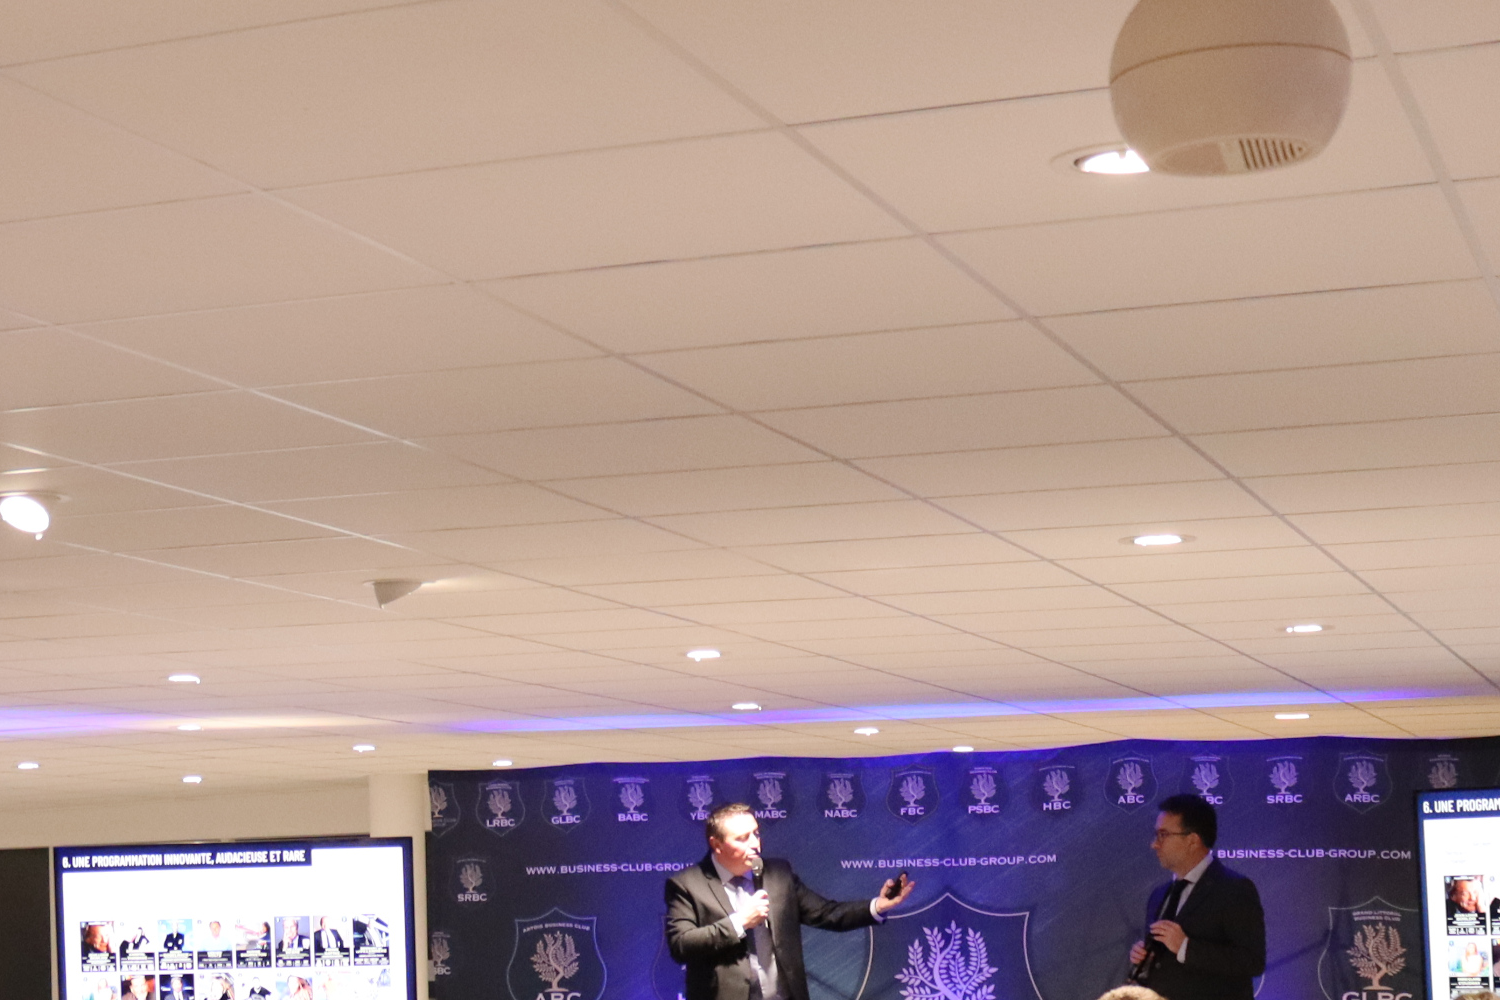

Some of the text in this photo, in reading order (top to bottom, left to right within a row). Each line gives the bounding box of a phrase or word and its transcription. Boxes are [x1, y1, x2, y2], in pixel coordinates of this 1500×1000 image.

[1117, 795, 1145, 805] ABC
[1266, 794, 1303, 804] SRBC
[1344, 793, 1380, 803] ARBC
[968, 805, 999, 814] PSBC
[1043, 801, 1071, 811] HBC
[1422, 801, 1433, 814] 6.
[1433, 800, 1455, 813] UNE
[754, 810, 787, 819] MABC
[824, 809, 857, 818] NABC
[900, 807, 925, 816] FBC
[551, 815, 581, 825] GLBC
[618, 813, 648, 822] BABC
[486, 818, 515, 828] LRBC
[72, 855, 91, 868] UNE
[91, 853, 162, 868] PROGRAMMATION
[163, 852, 215, 866] INNOVANTE,
[215, 850, 268, 864] AUDACIEUSE
[269, 850, 281, 863] ET
[282, 849, 306, 862] RARE
[841, 854, 1057, 868] WWW.BUSINESS-CLUB-GROUP.COM
[457, 893, 487, 902] SRBC
[574, 923, 591, 931] CLUB
